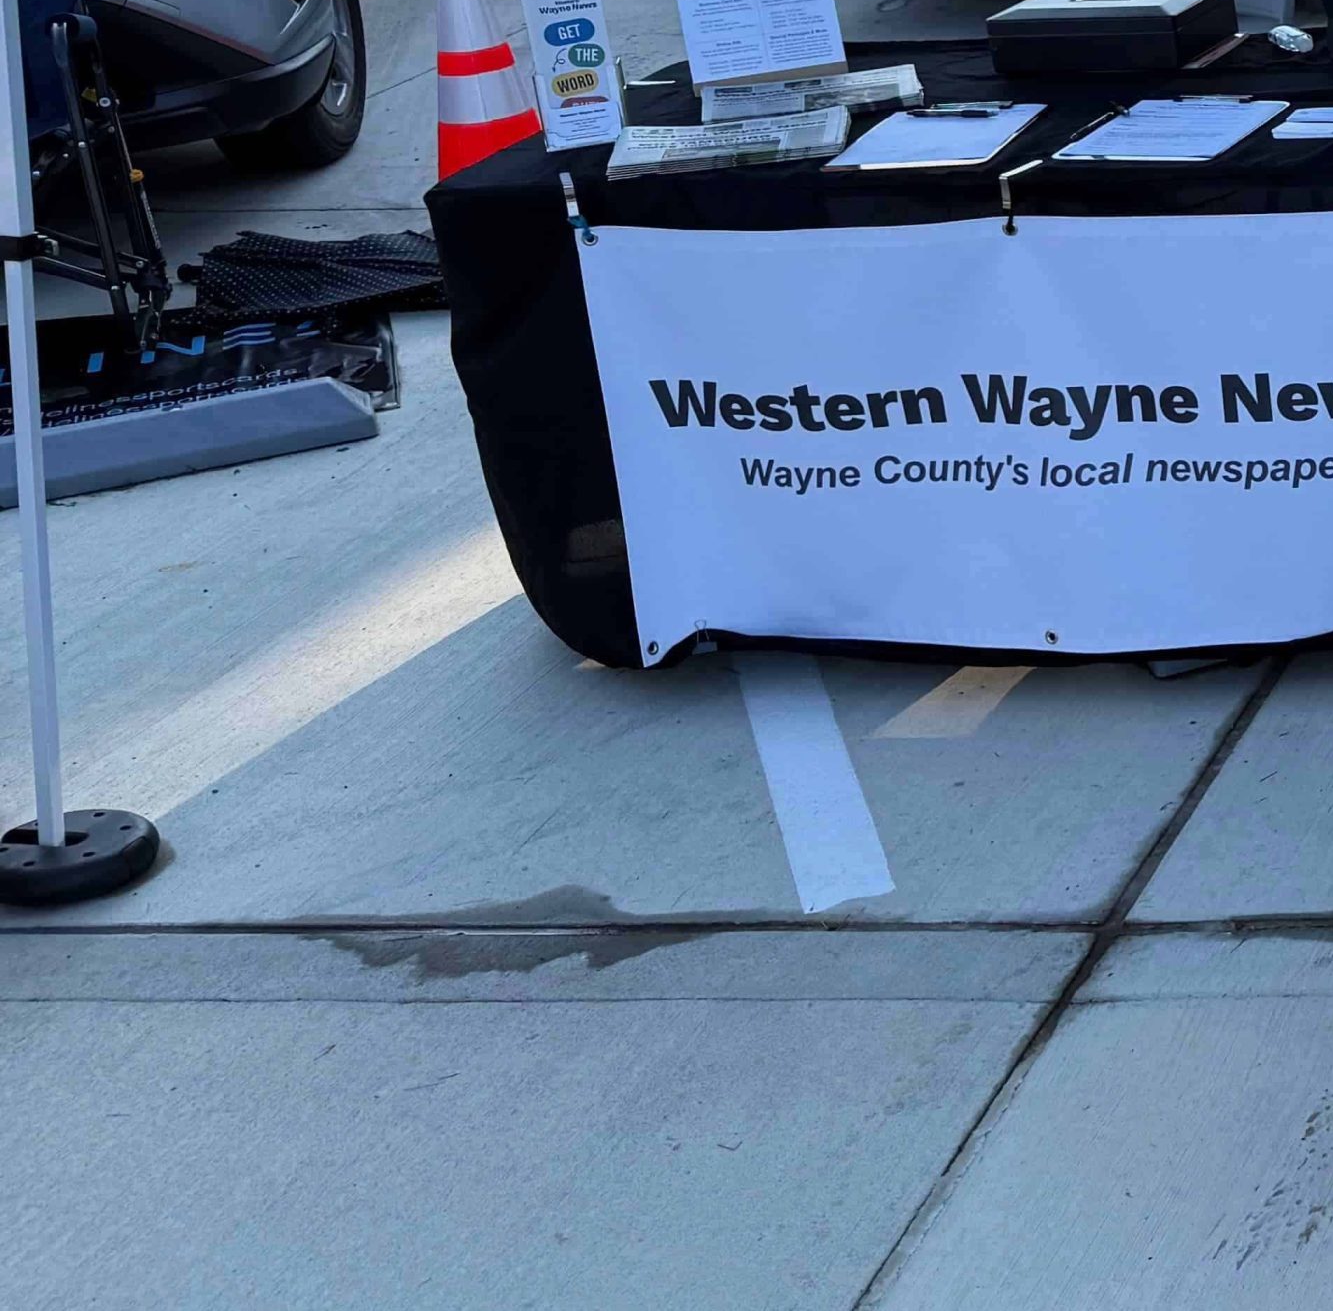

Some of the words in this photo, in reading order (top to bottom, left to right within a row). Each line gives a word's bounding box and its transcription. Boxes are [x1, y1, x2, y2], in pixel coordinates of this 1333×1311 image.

[539, 5, 571, 14] Wayne
[572, 2, 597, 10] News
[558, 23, 580, 40] GET
[576, 48, 599, 62] THE
[557, 73, 594, 93] WORD
[648, 379, 948, 432] Western
[960, 373, 1199, 441] Wayne
[739, 457, 861, 496] Wayne
[874, 454, 1029, 491] County's
[1040, 452, 1134, 488] local
